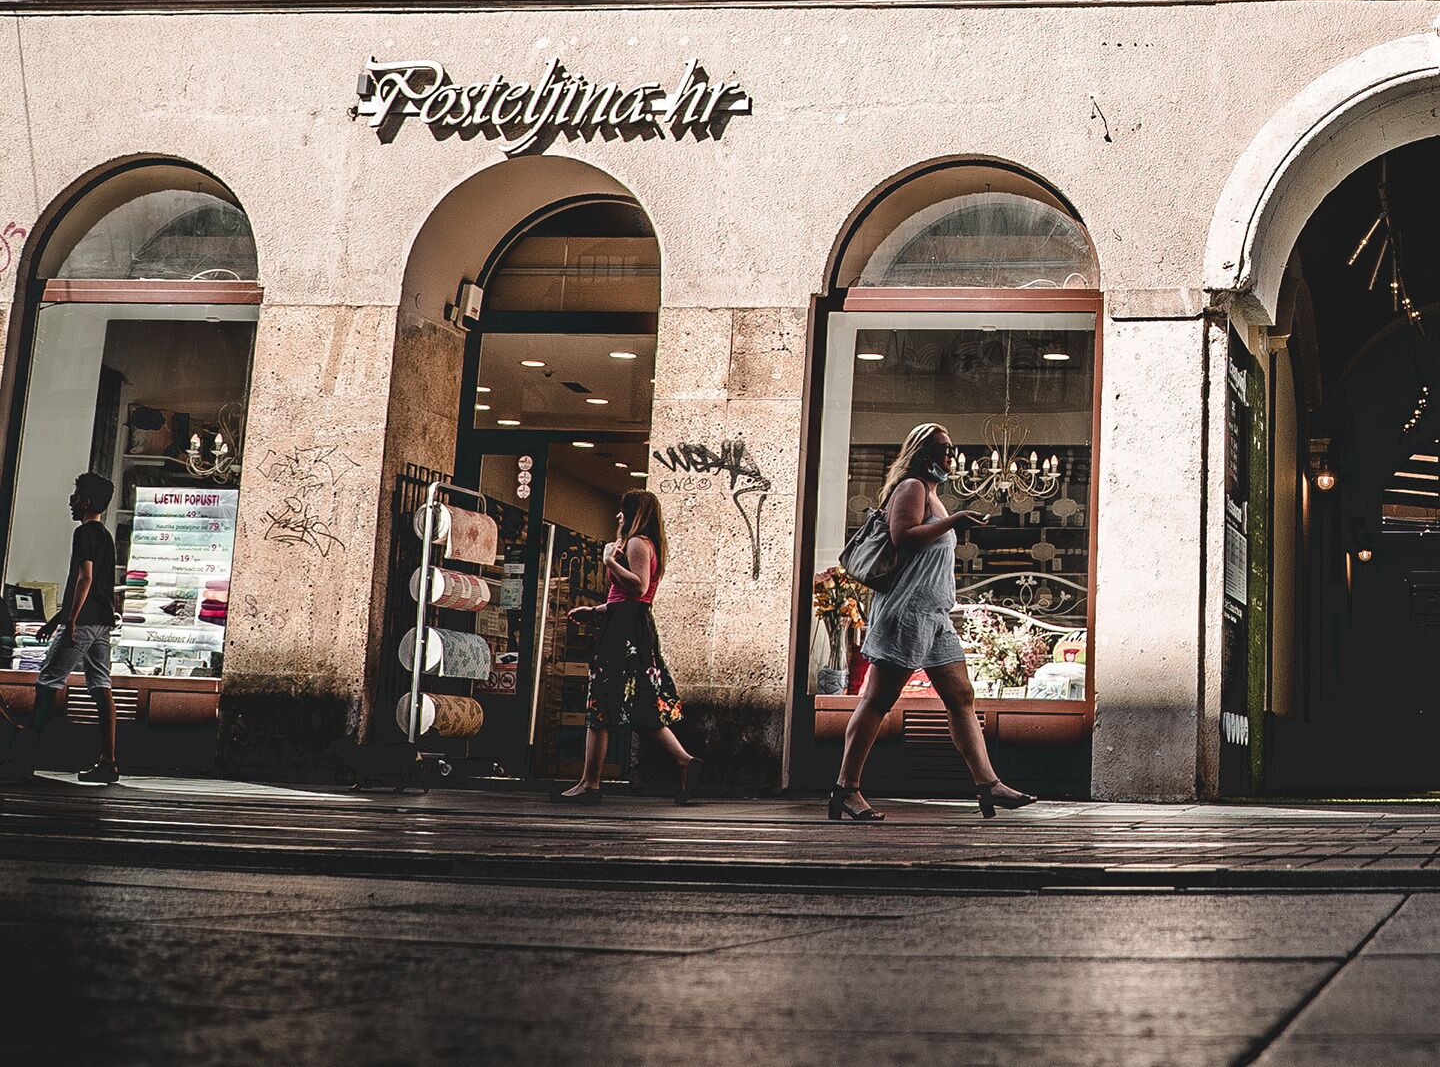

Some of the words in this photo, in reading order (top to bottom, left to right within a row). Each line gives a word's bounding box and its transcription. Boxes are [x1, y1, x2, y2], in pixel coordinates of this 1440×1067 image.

[366, 56, 742, 154] Posteljina.hr
[154, 493, 183, 505] LJETNI
[185, 494, 220, 506] POPUSTI
